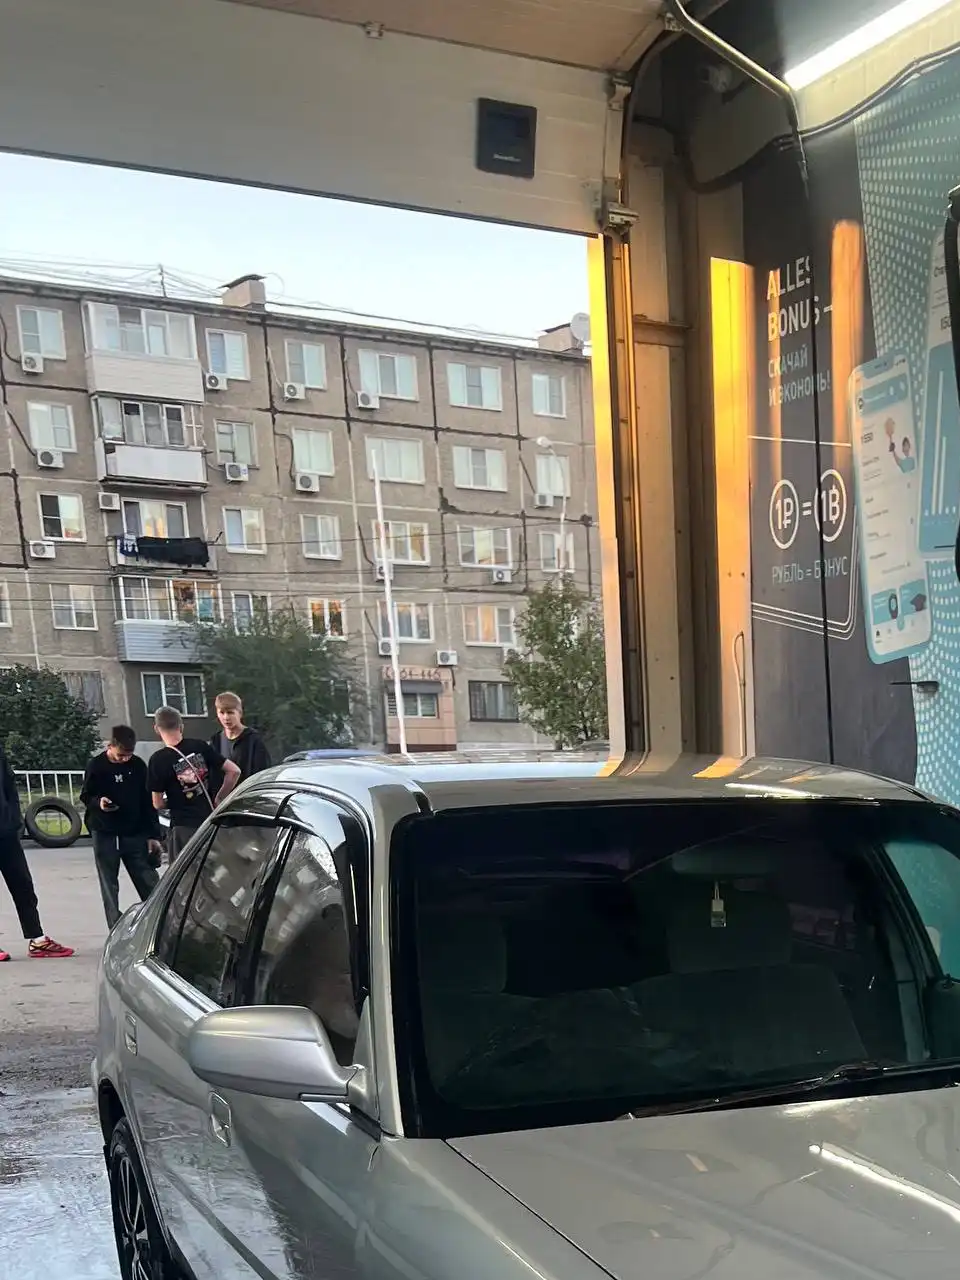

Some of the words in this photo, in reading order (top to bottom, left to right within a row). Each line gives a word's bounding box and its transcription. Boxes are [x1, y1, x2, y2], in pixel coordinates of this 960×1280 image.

[768, 344, 808, 378] СКАЧАЙ
[772, 563, 804, 584] РУБЛЬ
[814, 556, 848, 579] БНУС
